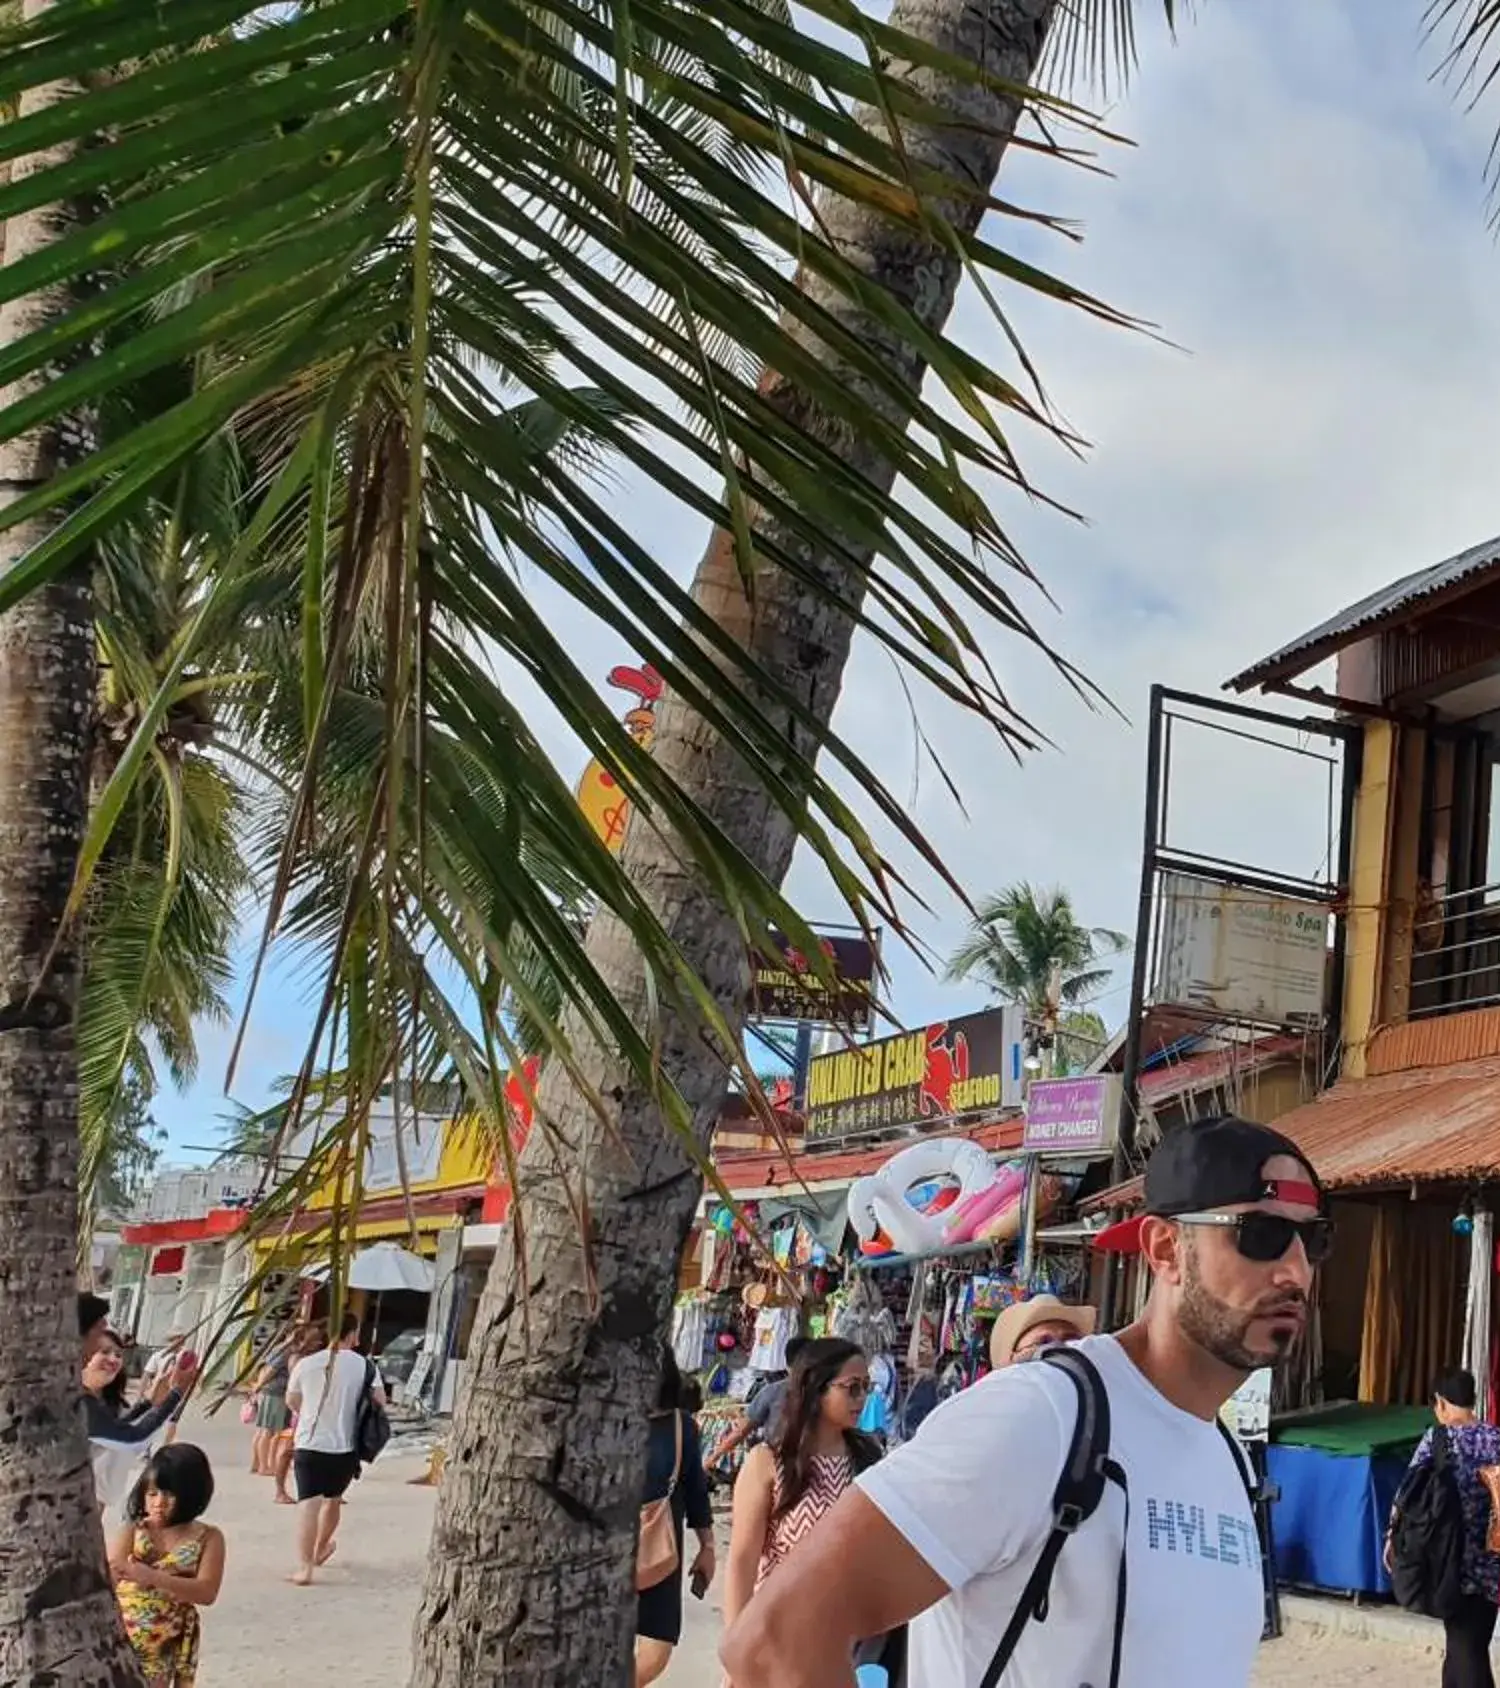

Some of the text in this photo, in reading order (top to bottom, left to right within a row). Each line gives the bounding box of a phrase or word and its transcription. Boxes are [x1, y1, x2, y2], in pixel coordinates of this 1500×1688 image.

[1295, 911, 1321, 933] Spa
[810, 1031, 927, 1107] UNLIMITED CRAB
[951, 1073, 1000, 1109] SEAFOOD
[1057, 1119, 1098, 1137] CHANGER
